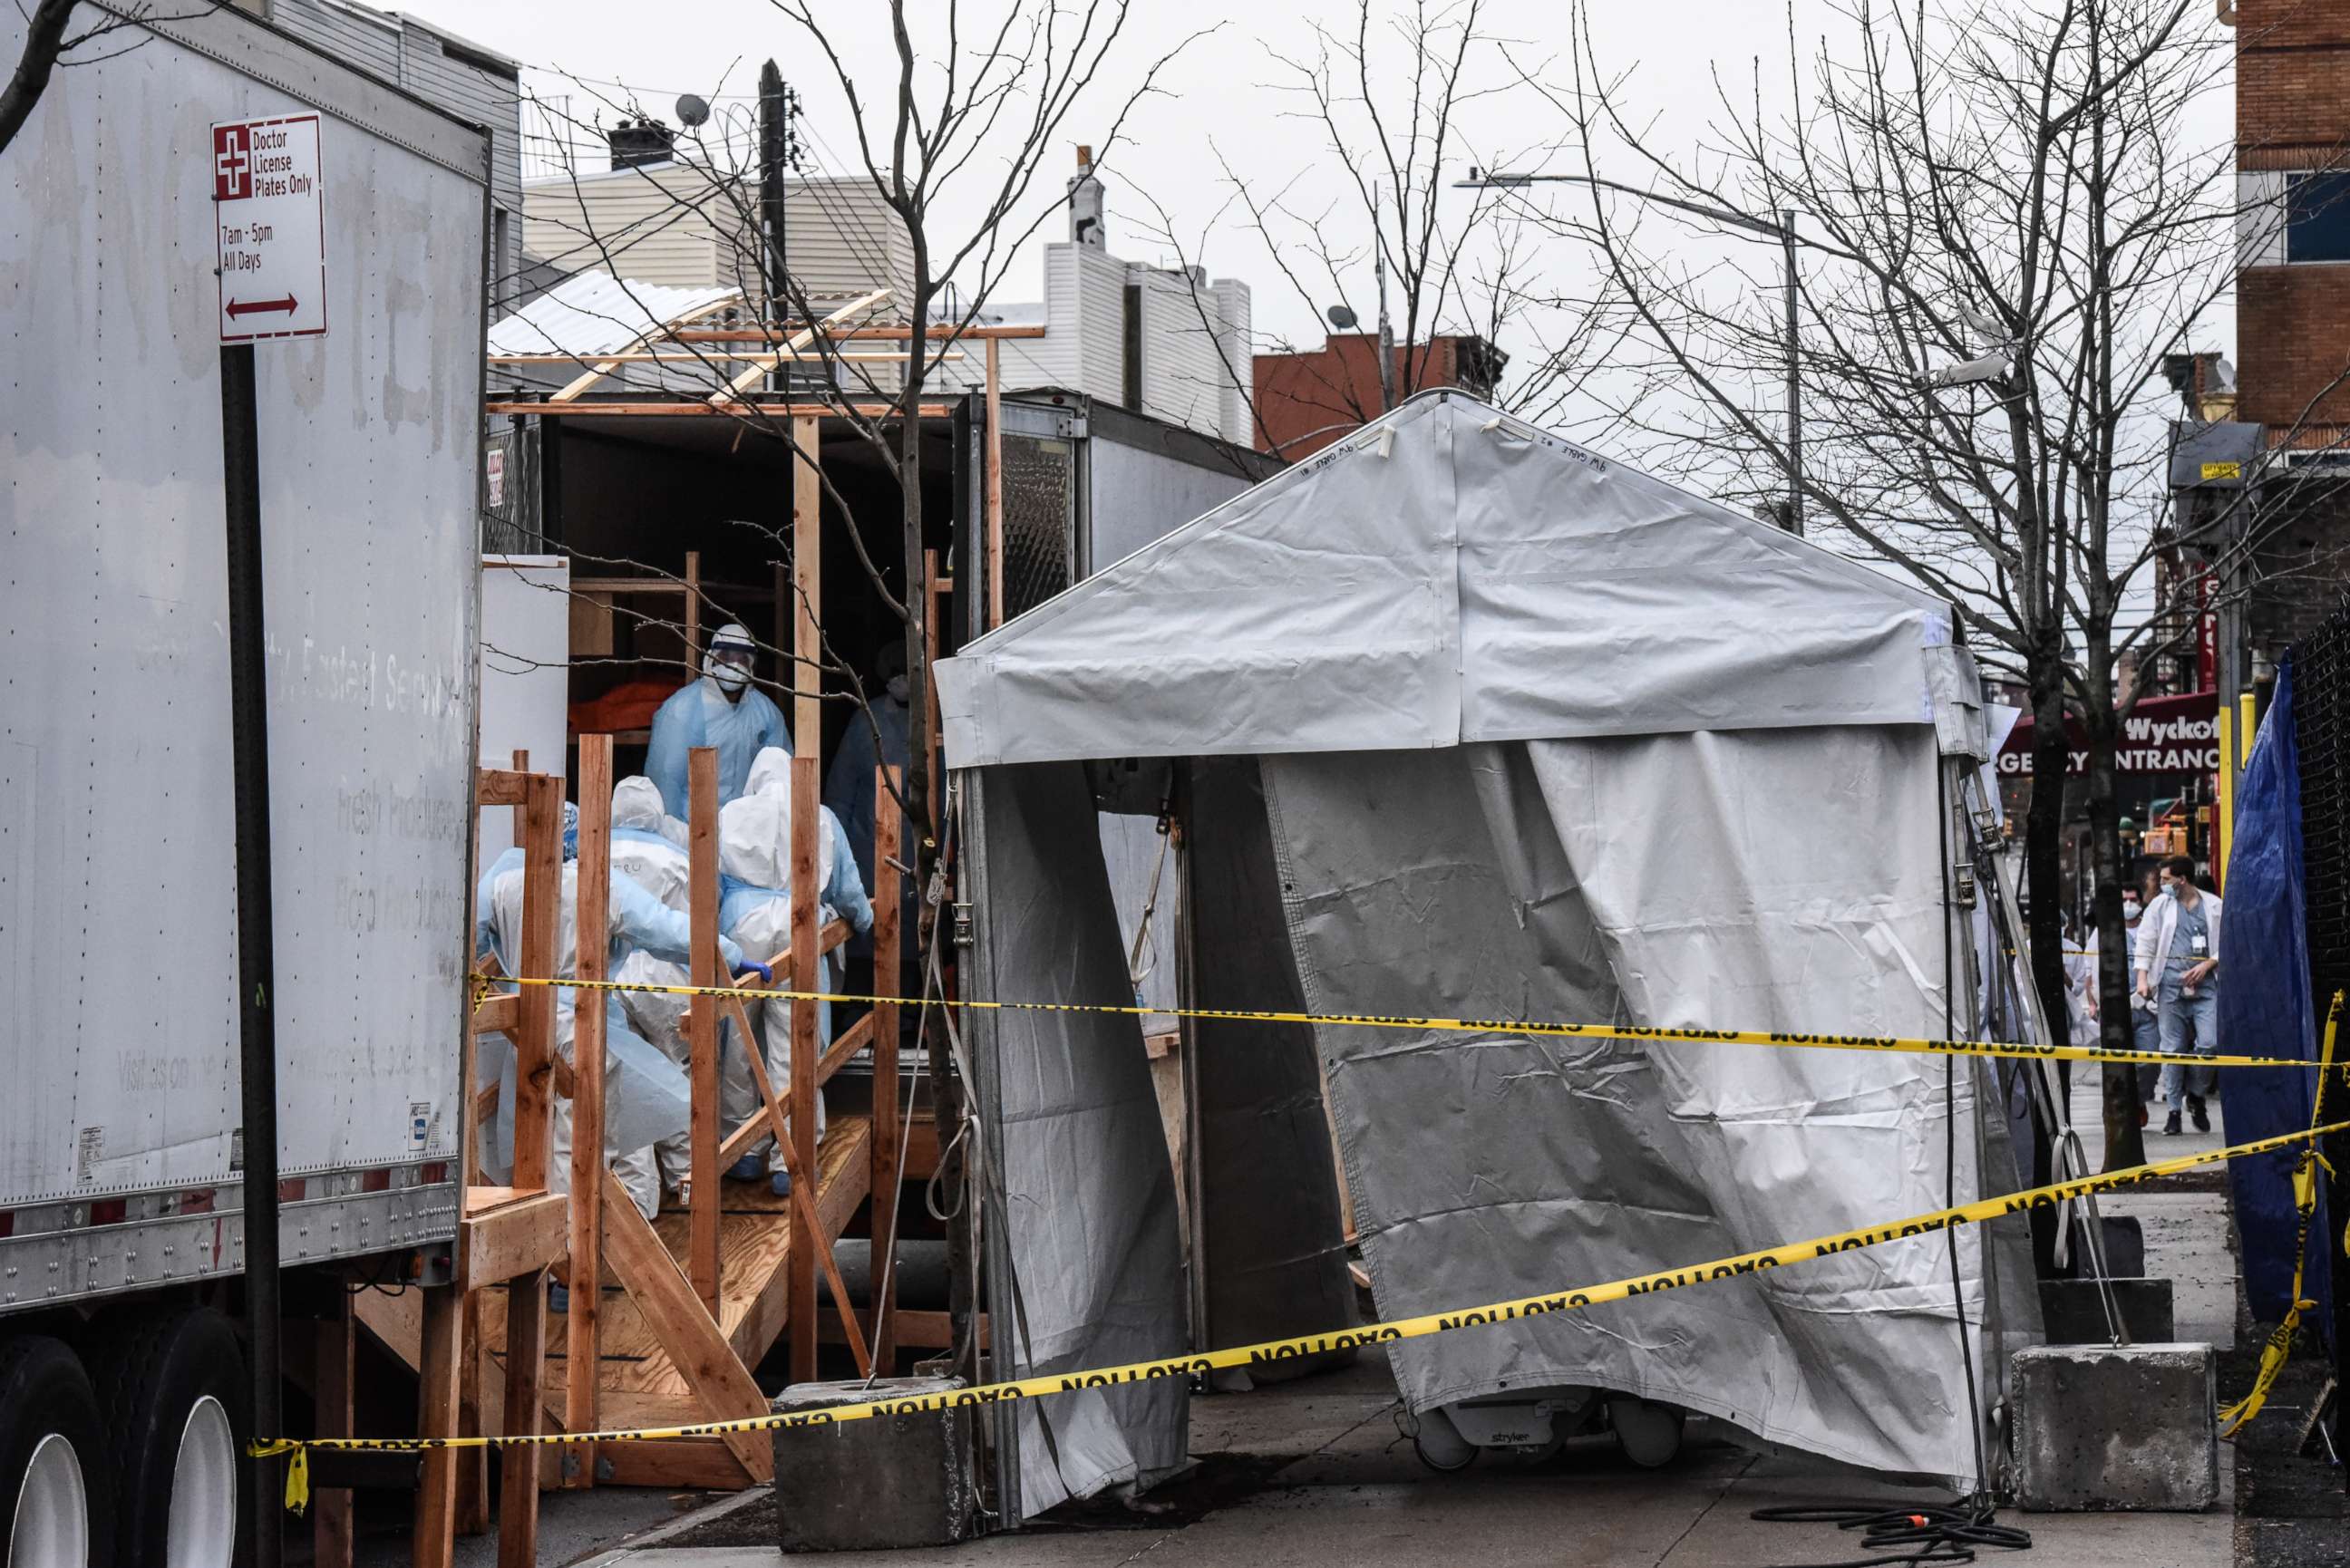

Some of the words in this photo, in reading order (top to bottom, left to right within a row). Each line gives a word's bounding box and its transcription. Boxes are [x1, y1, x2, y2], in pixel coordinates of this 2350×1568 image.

[253, 131, 287, 150] Doctor
[254, 154, 292, 174] License
[255, 177, 286, 198] Plates
[289, 175, 312, 197] Only
[222, 227, 242, 244] 7am
[251, 222, 273, 247] 5pm
[223, 252, 236, 271] All
[238, 250, 261, 273] Days
[1561, 445, 1588, 462] GABLE
[116, 1049, 145, 1092] Visit
[1492, 1433, 1529, 1444] stryker
